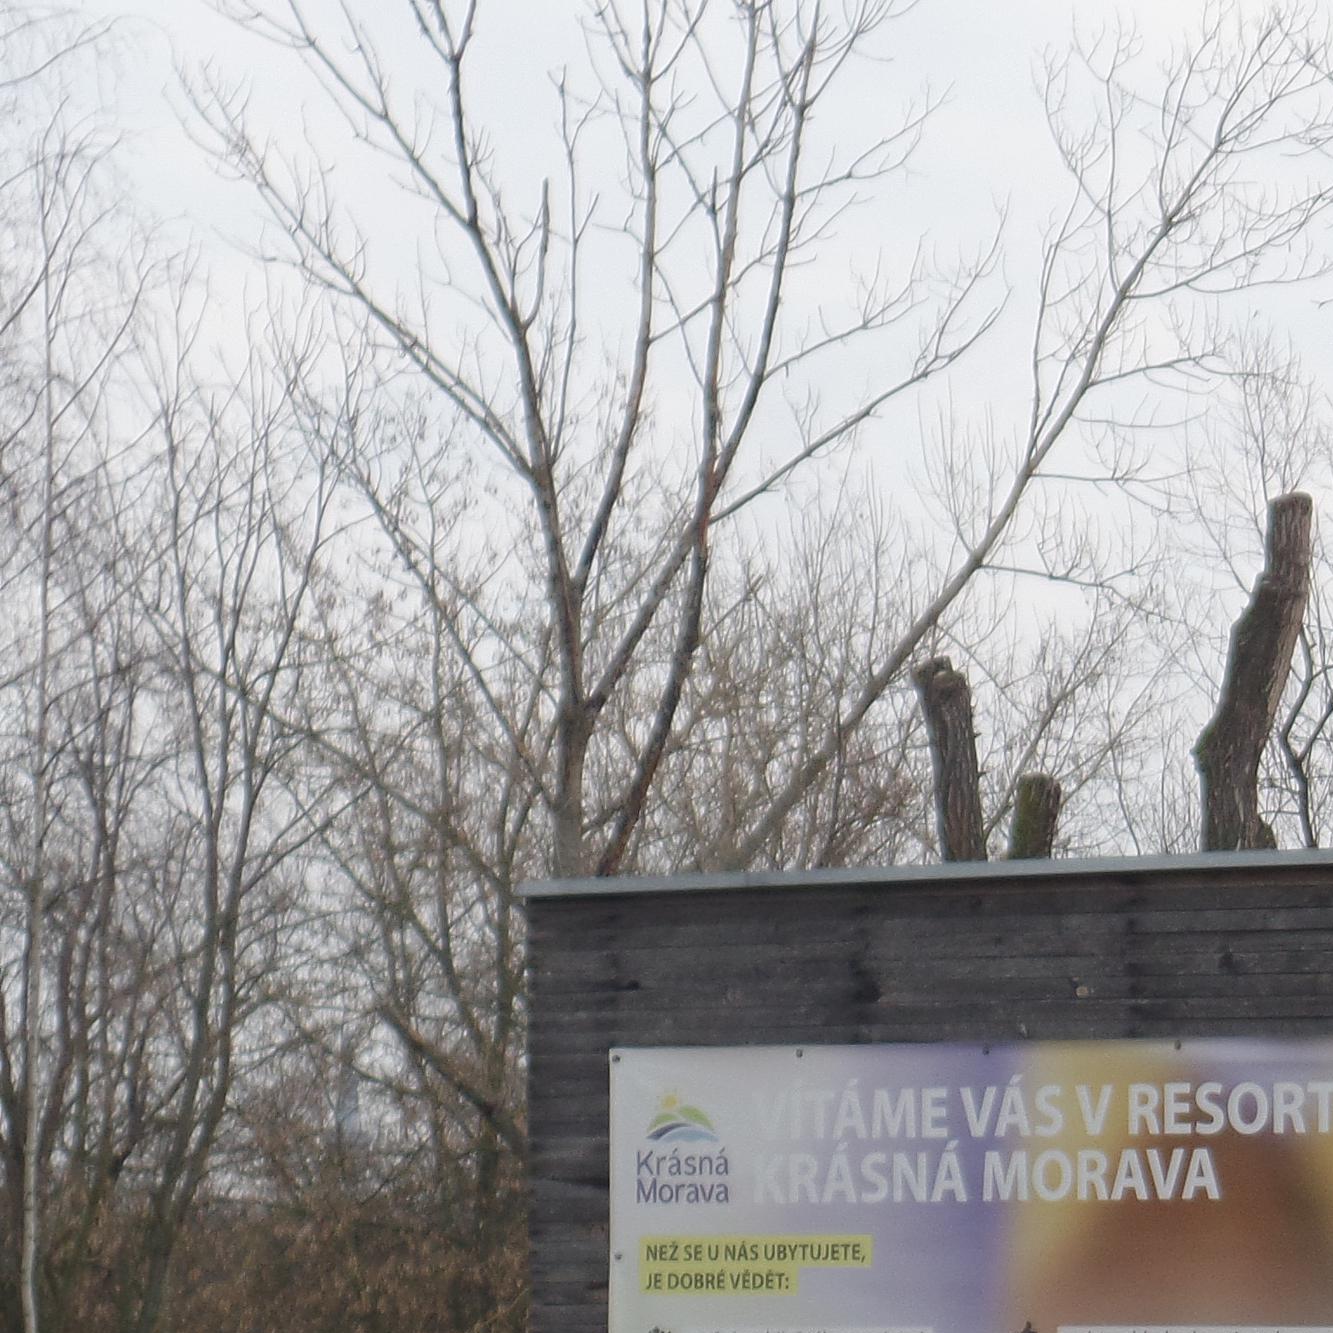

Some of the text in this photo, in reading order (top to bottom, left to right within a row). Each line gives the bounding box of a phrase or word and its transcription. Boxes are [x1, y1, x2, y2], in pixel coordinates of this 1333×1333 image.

[750, 1077, 948, 1140] VÍTÁME
[960, 1074, 1064, 1139] VÁS
[1074, 1085, 1114, 1137] V
[636, 1147, 729, 1177] Krásná
[751, 1140, 1220, 1204] KRÁSNÁ MORAVA
[636, 1178, 729, 1204] Morava
[646, 1240, 866, 1263] NEŽ SE U NÁS UBYTUJETE,
[645, 1268, 790, 1291] JE DOBRÉ VĚDĚT:
